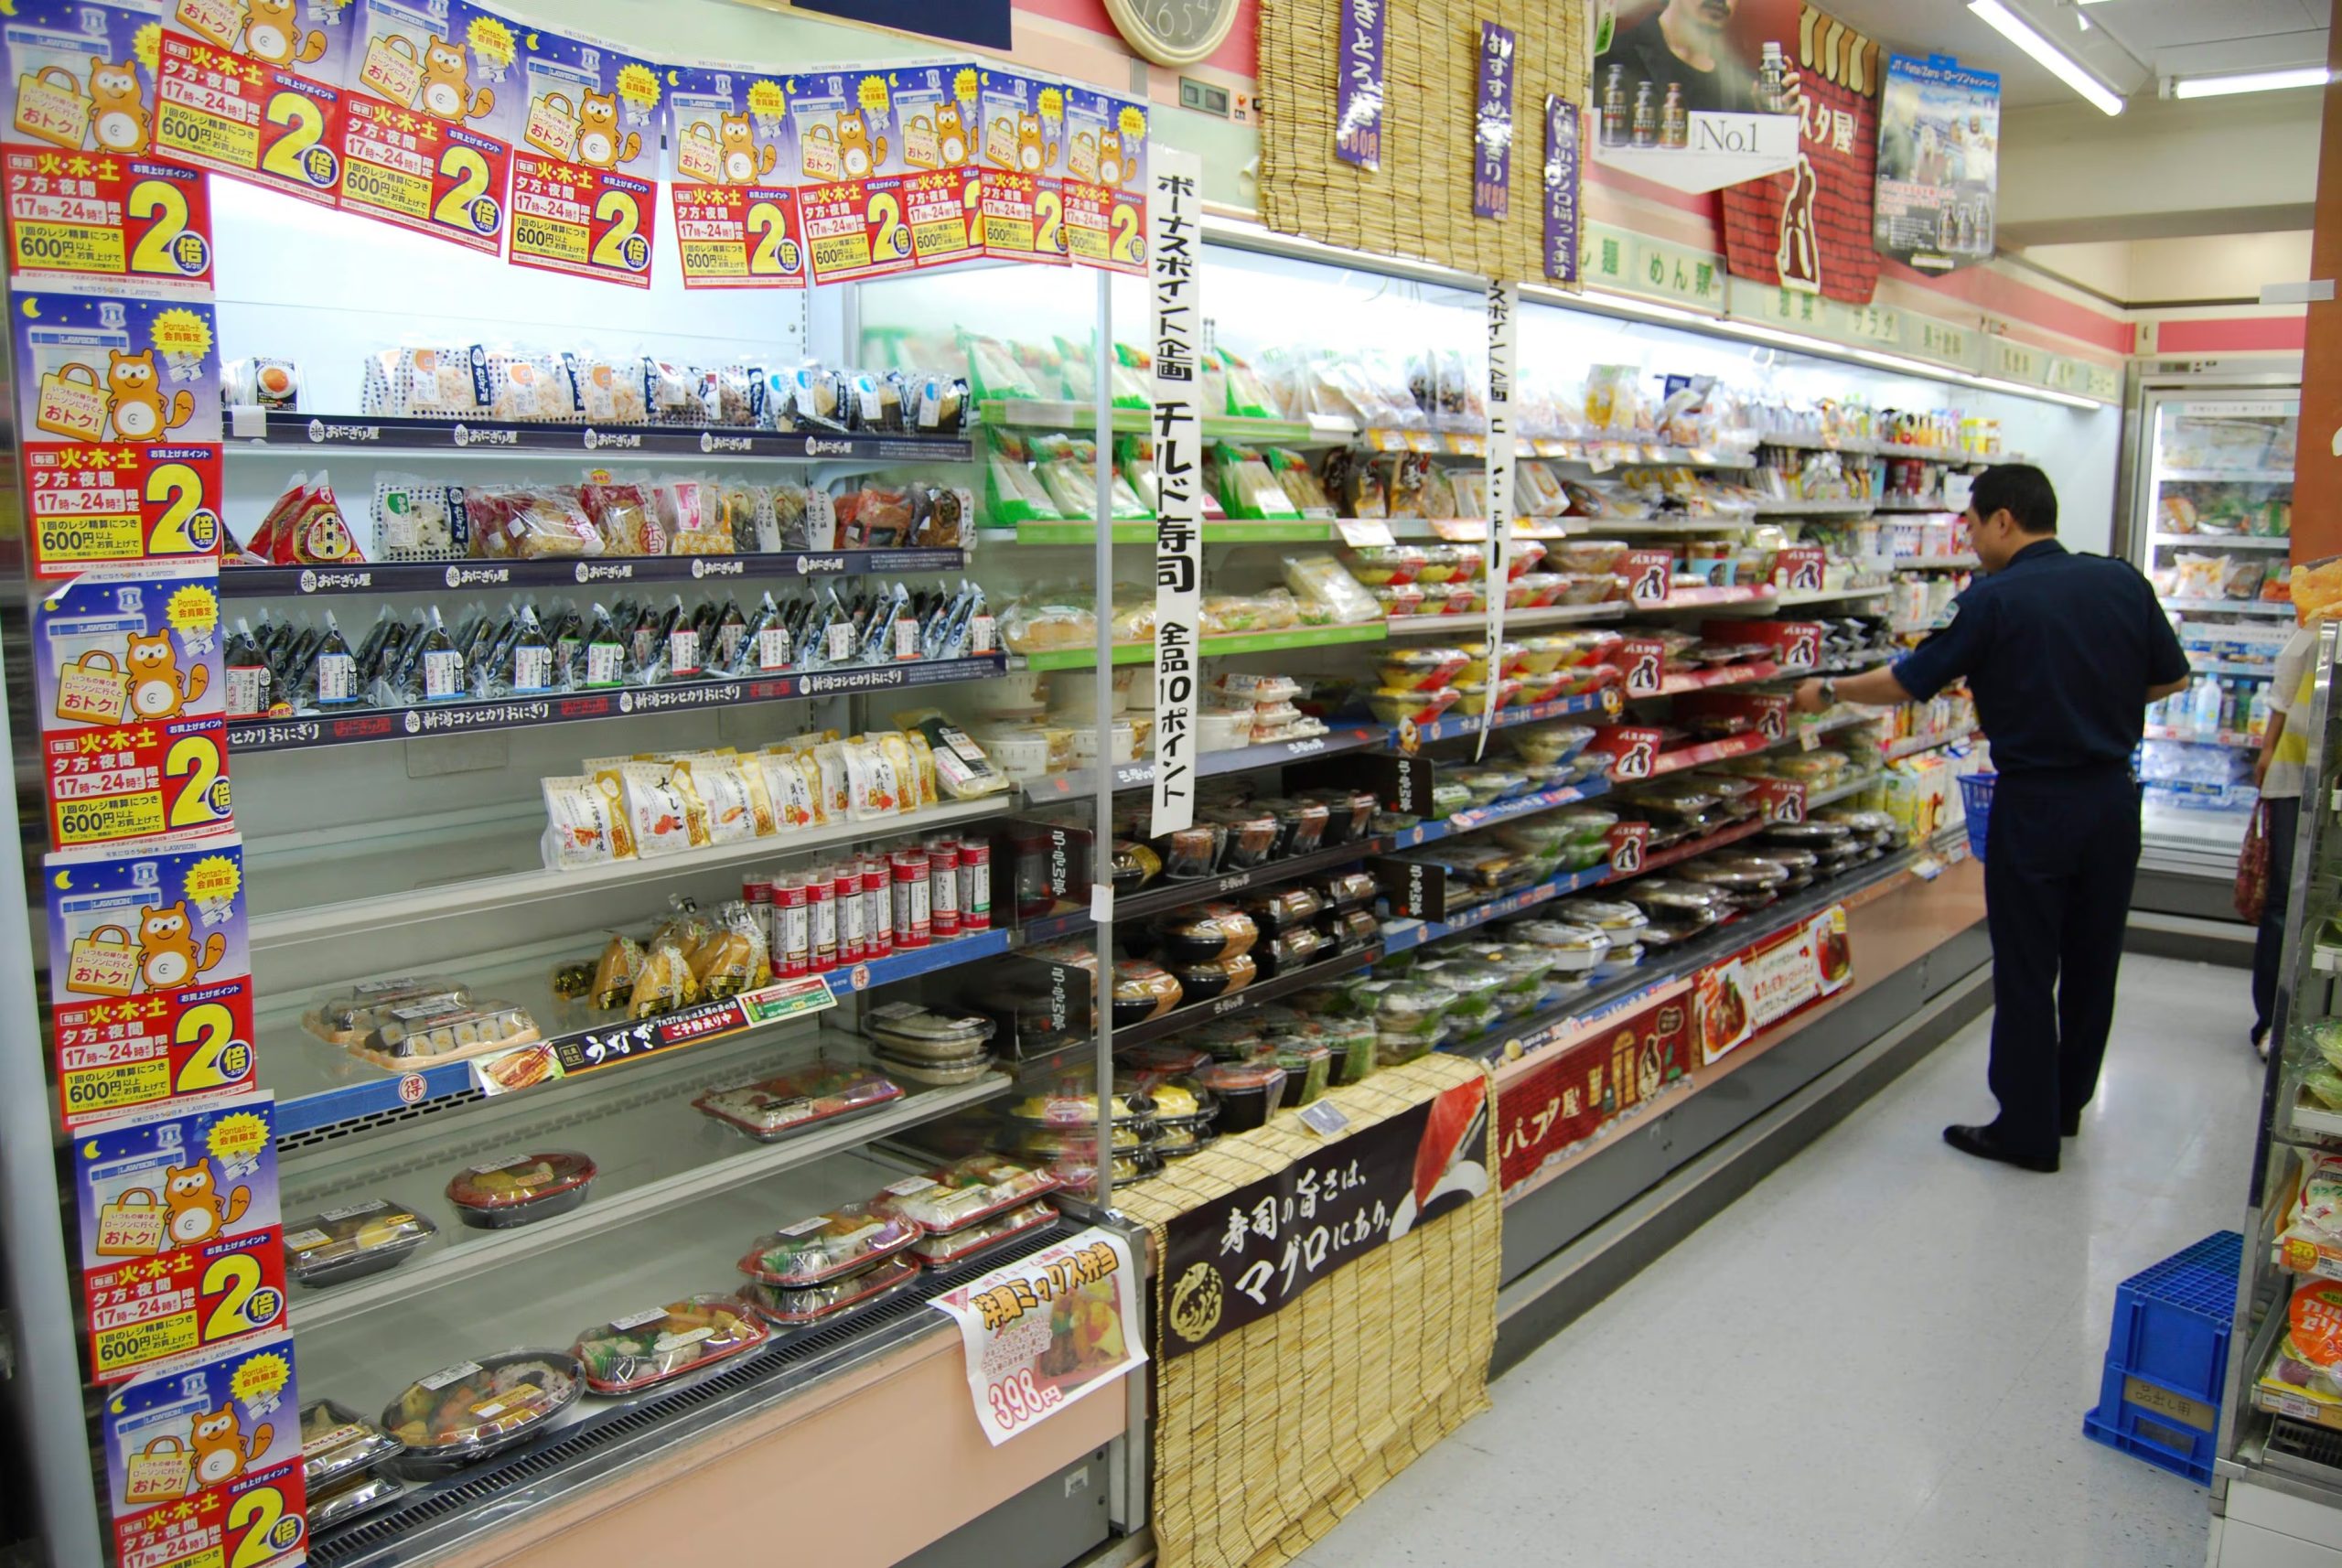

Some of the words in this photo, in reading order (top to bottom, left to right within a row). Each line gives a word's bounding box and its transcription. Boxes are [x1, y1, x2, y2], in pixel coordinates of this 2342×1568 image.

[183, 0, 235, 42] おトク!
[367, 61, 414, 101] おトク!
[23, 104, 81, 141] おトク!
[531, 121, 571, 154] おトク!
[1700, 119, 1761, 154] No.1
[1157, 175, 1194, 382] ボーナスポイント企画
[45, 403, 101, 433] おトク!
[326, 425, 380, 440] おにぎり屋
[469, 430, 517, 444] おにぎり屋
[1155, 402, 1196, 593] チルド寿司
[317, 573, 371, 587] おにぎり屋
[461, 569, 509, 583] おにぎり屋
[65, 692, 120, 715] おトク!
[424, 703, 549, 729] 新潟コシヒカリおにぎり
[1160, 621, 1192, 808] 全品10ポイント
[74, 966, 131, 986] おトク!
[672, 1012, 733, 1036] ご予約承り中
[586, 1023, 654, 1064] うなぎ
[1219, 1159, 1367, 1257] 寿司の旨さは、
[103, 1230, 157, 1246] おトク!
[970, 1241, 1119, 1331] 洋風ミックス弁当
[988, 1369, 1063, 1430] 398円
[2135, 1381, 2193, 1417] 品出し用
[133, 1475, 184, 1494] おトク!
